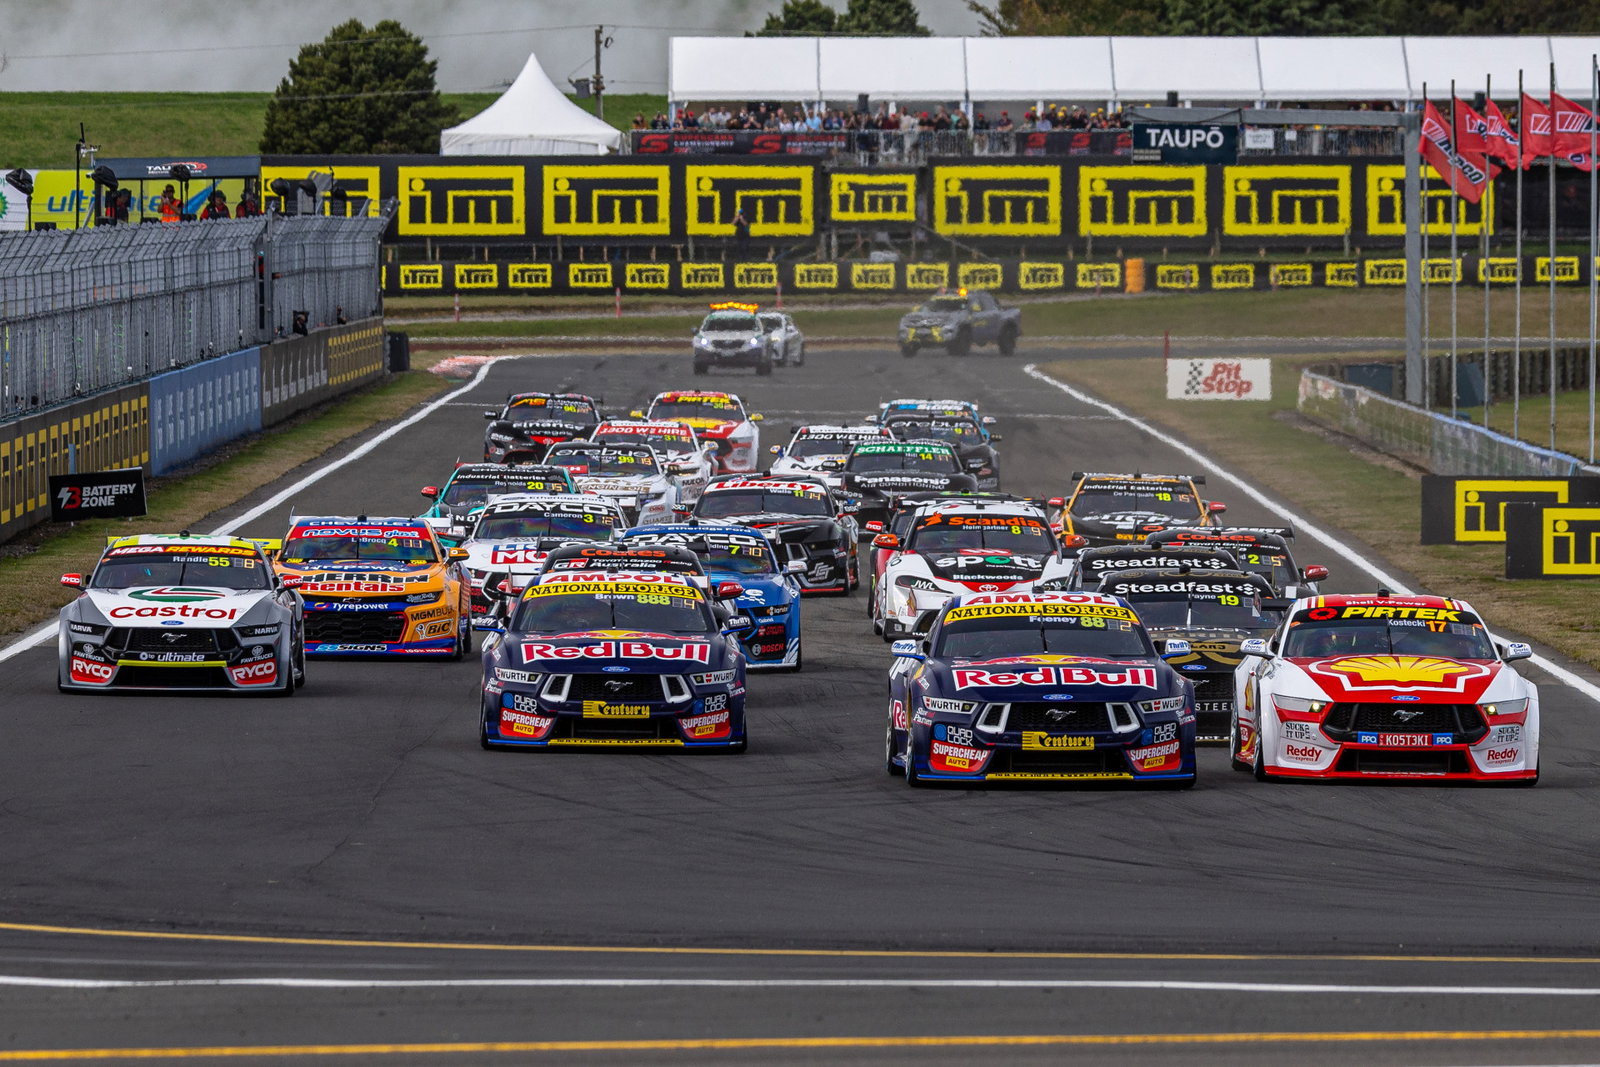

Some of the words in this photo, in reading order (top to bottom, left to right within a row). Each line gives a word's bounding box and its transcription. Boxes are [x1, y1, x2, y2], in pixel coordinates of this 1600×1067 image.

[1208, 362, 1243, 381] Pit
[1201, 377, 1252, 398] Stop
[599, 427, 630, 435] 1300
[556, 447, 649, 458] erebus
[856, 445, 952, 455] SCHAEFFLER
[617, 456, 635, 464] 99
[526, 481, 544, 490] 20
[715, 481, 816, 491] Liberty
[854, 475, 951, 485] Panasonic
[878, 482, 945, 490] CONDITIONING
[82, 483, 136, 497] BATTERY
[793, 490, 804, 498] 11
[81, 495, 115, 508] ZONE
[1155, 492, 1172, 502] 18
[494, 502, 609, 515] DAYCO
[309, 520, 414, 528] CHEVROLET
[543, 512, 583, 520] Cameron
[583, 513, 594, 524] 3
[949, 517, 1041, 527] Scandia
[383, 530, 419, 539] glass
[667, 525, 723, 533] Etheridge
[1010, 525, 1022, 535] 8
[387, 538, 399, 548] 4
[633, 533, 757, 547] DAYCO
[1176, 533, 1257, 542] Coates
[109, 545, 164, 556] MEGA
[165, 545, 257, 557] REWARDS
[580, 547, 666, 558] Coates
[728, 544, 740, 555] 7
[173, 555, 208, 564] Randle
[208, 556, 230, 568] 55
[554, 560, 586, 570] GR
[590, 561, 657, 570] Australia
[1091, 556, 1202, 570] Steadfast
[1247, 553, 1260, 565] 2
[1271, 556, 1283, 567] 5
[544, 573, 684, 585] AMPOL
[952, 573, 1023, 581] Blackwoods
[298, 582, 405, 593] Rentals
[530, 584, 611, 596] NATIONAL
[616, 584, 696, 598] STORAGE
[911, 580, 935, 591] JWL
[1114, 581, 1234, 596] Steadfast
[594, 593, 635, 601] Brown
[636, 594, 671, 605] 888
[964, 594, 1117, 606] AMPOL
[1217, 594, 1239, 606] 19
[110, 604, 237, 620] Castrol
[333, 602, 389, 612] Tyrepower
[950, 605, 1041, 620] NATIONAL
[1046, 604, 1129, 619] STORAGE
[1341, 606, 1462, 623] PIRTEK
[728, 616, 751, 627] Thrifty
[1029, 615, 1077, 625] Feeney
[1080, 616, 1106, 629] 88
[1119, 621, 1132, 633] 2
[1388, 618, 1426, 628] Kostecki
[1426, 620, 1448, 633] 17
[254, 625, 280, 636] NARVA
[337, 644, 388, 652] SIGNS
[761, 642, 784, 653] BOSCH
[892, 642, 916, 652] Thrifty
[157, 652, 205, 662] ultimate
[521, 642, 616, 664] Red
[619, 642, 711, 665] Bull
[72, 659, 113, 680] RYCO
[231, 661, 275, 681] RYCO
[952, 667, 1058, 691] Red
[1059, 667, 1158, 691] Bull
[514, 694, 537, 708] QUAD
[705, 693, 727, 706] QUAD
[514, 702, 538, 715] LOCK
[596, 701, 651, 718] Century
[705, 701, 727, 714] LOCK
[502, 710, 551, 732] SUPERCHEAP
[682, 711, 730, 730] SUPERCHEAP
[515, 723, 533, 734] AUTO
[697, 724, 714, 735] AUTO
[947, 725, 973, 740] QUAD
[1153, 721, 1177, 736] QUAD
[1285, 722, 1304, 732] SUCK
[1497, 726, 1515, 735] SUCK
[1038, 732, 1095, 750] Century
[1153, 731, 1176, 745] LOCK
[1285, 730, 1294, 738] IT
[1294, 731, 1305, 740] UP
[1360, 735, 1378, 744] PPQ
[1436, 736, 1452, 745] PPQ
[1496, 734, 1505, 743] IT
[1505, 734, 1515, 742] UP
[947, 735, 974, 748] LOCK
[933, 743, 989, 763] SUPERCHEAP
[1130, 742, 1180, 762] SUPERCHEAP
[1286, 744, 1322, 761] Reddy
[1487, 747, 1519, 763] Reddy
[947, 757, 968, 767] AUTO
[1145, 757, 1165, 768] AUTO
